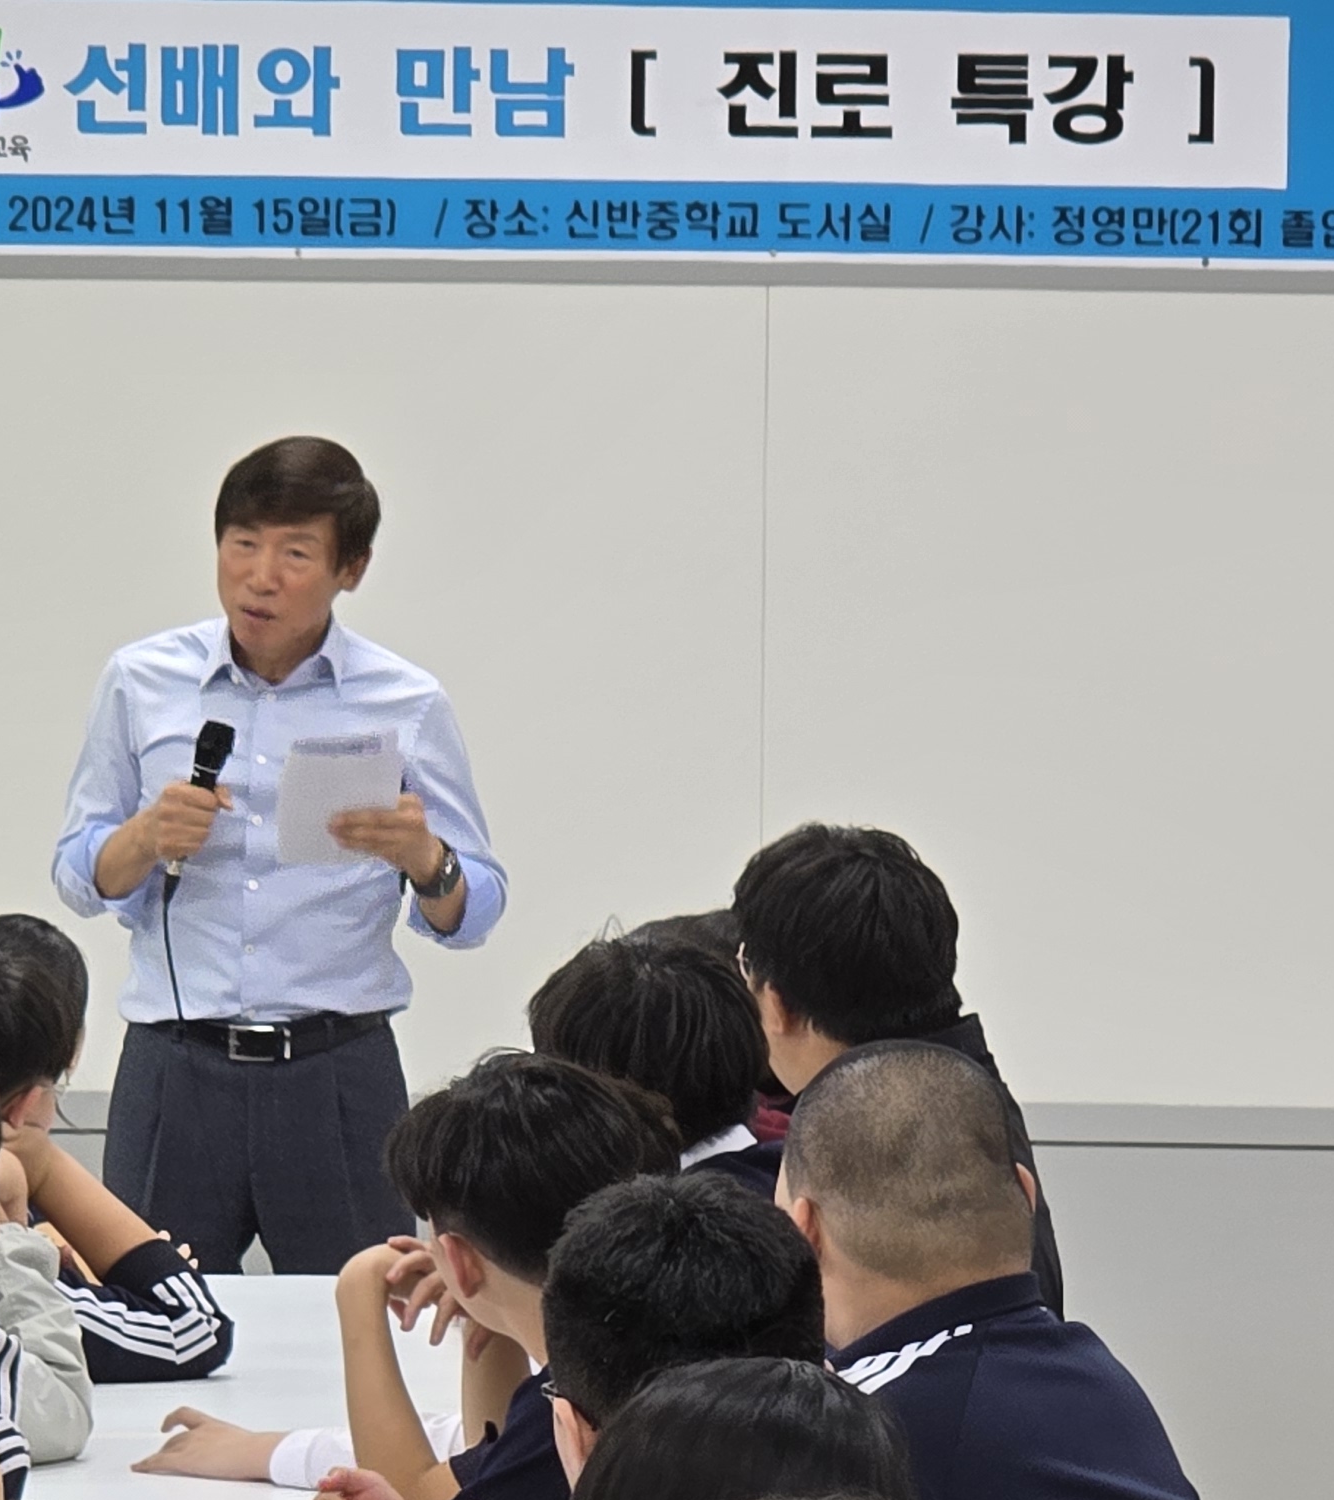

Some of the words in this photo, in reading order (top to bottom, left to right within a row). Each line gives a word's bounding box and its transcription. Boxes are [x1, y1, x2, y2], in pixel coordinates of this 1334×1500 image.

[63, 41, 341, 137] 선배와
[395, 45, 576, 138] 만남
[717, 50, 894, 139] 진로
[950, 54, 1134, 145] 특강
[8, 194, 137, 236] 2024년
[154, 195, 234, 237] 11월
[251, 195, 397, 238] 15일(금)
[464, 198, 550, 239] 장소:
[566, 199, 759, 243] 신반중학교
[777, 202, 892, 244] 도서실
[949, 205, 1035, 244] 강사:
[1052, 205, 1262, 249] 정영만(21회
